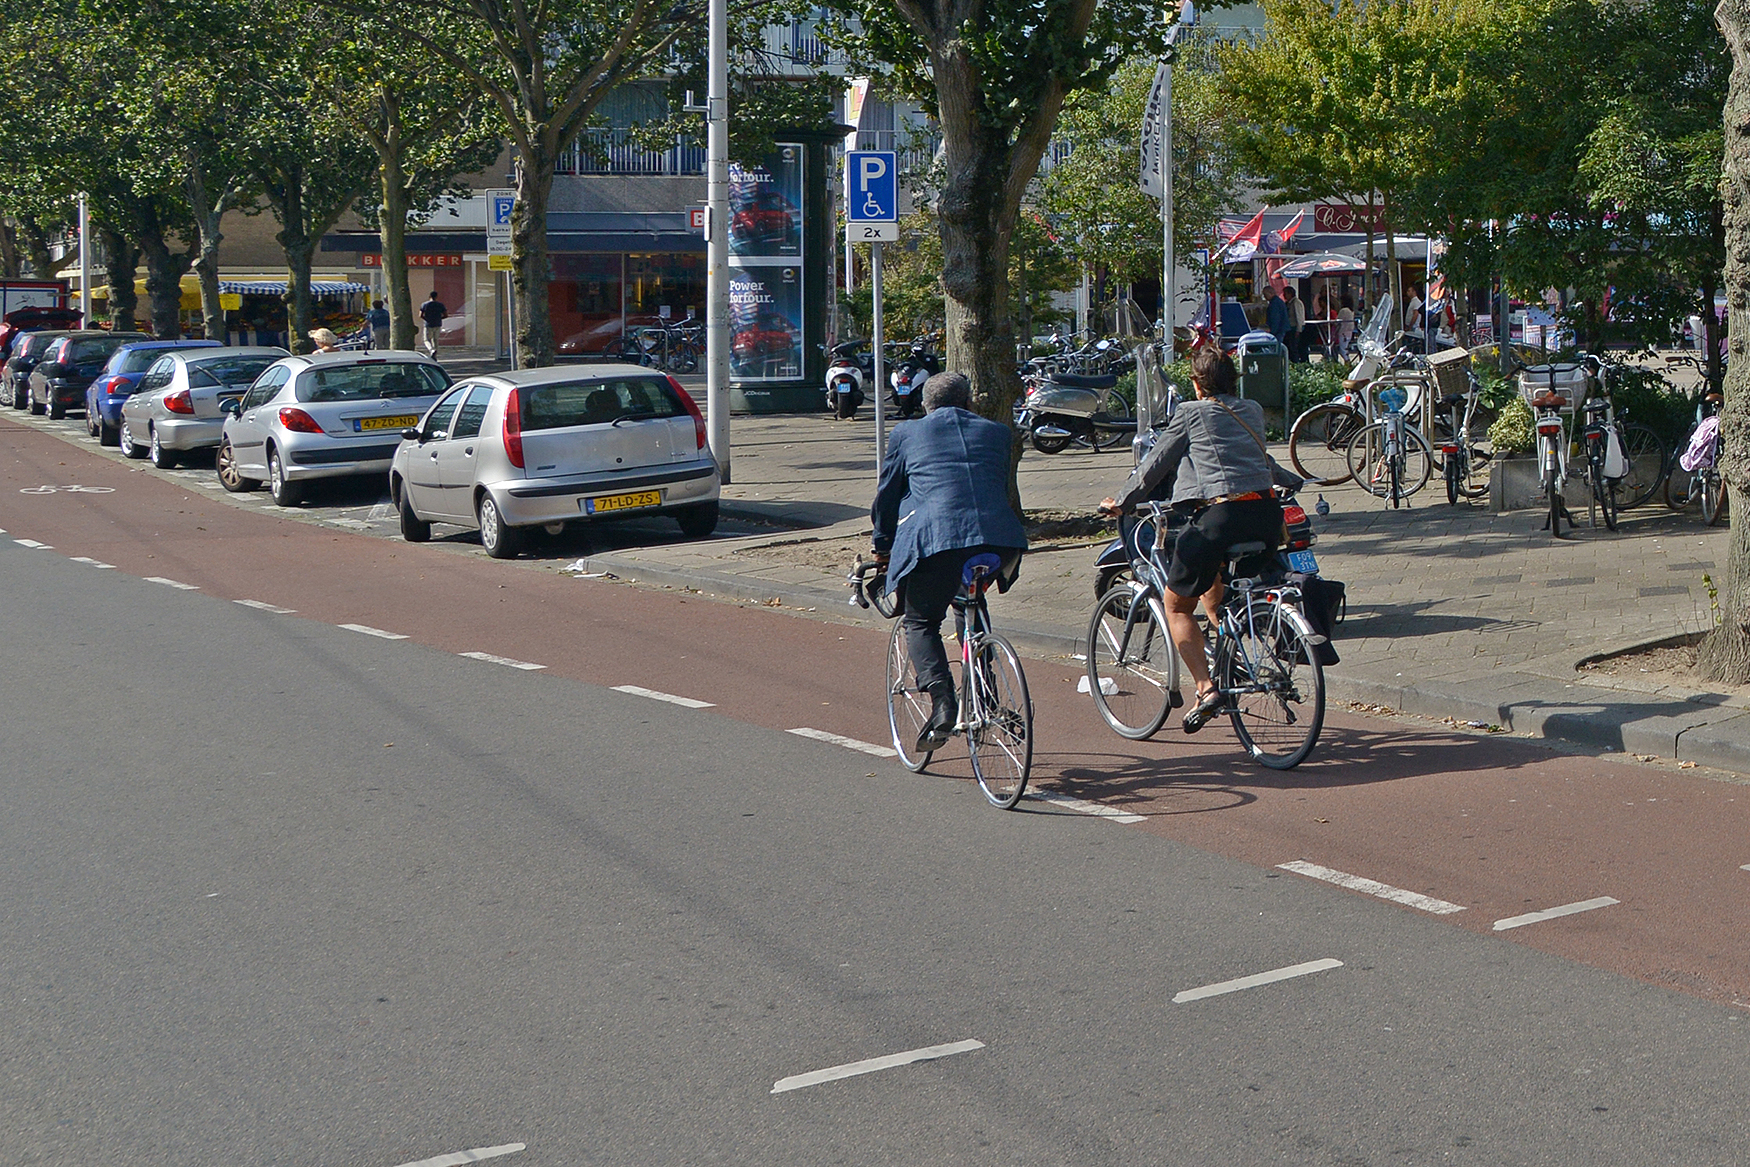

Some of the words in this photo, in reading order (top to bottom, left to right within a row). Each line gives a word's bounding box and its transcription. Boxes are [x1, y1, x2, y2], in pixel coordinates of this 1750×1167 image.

[860, 157, 887, 192] P
[863, 227, 881, 238] 2x
[364, 255, 461, 265] BKKER
[729, 280, 764, 291] Power
[729, 291, 774, 303] forfour.
[364, 417, 415, 428] 47-ZD-ND
[601, 493, 653, 509] 71-LD-ZS
